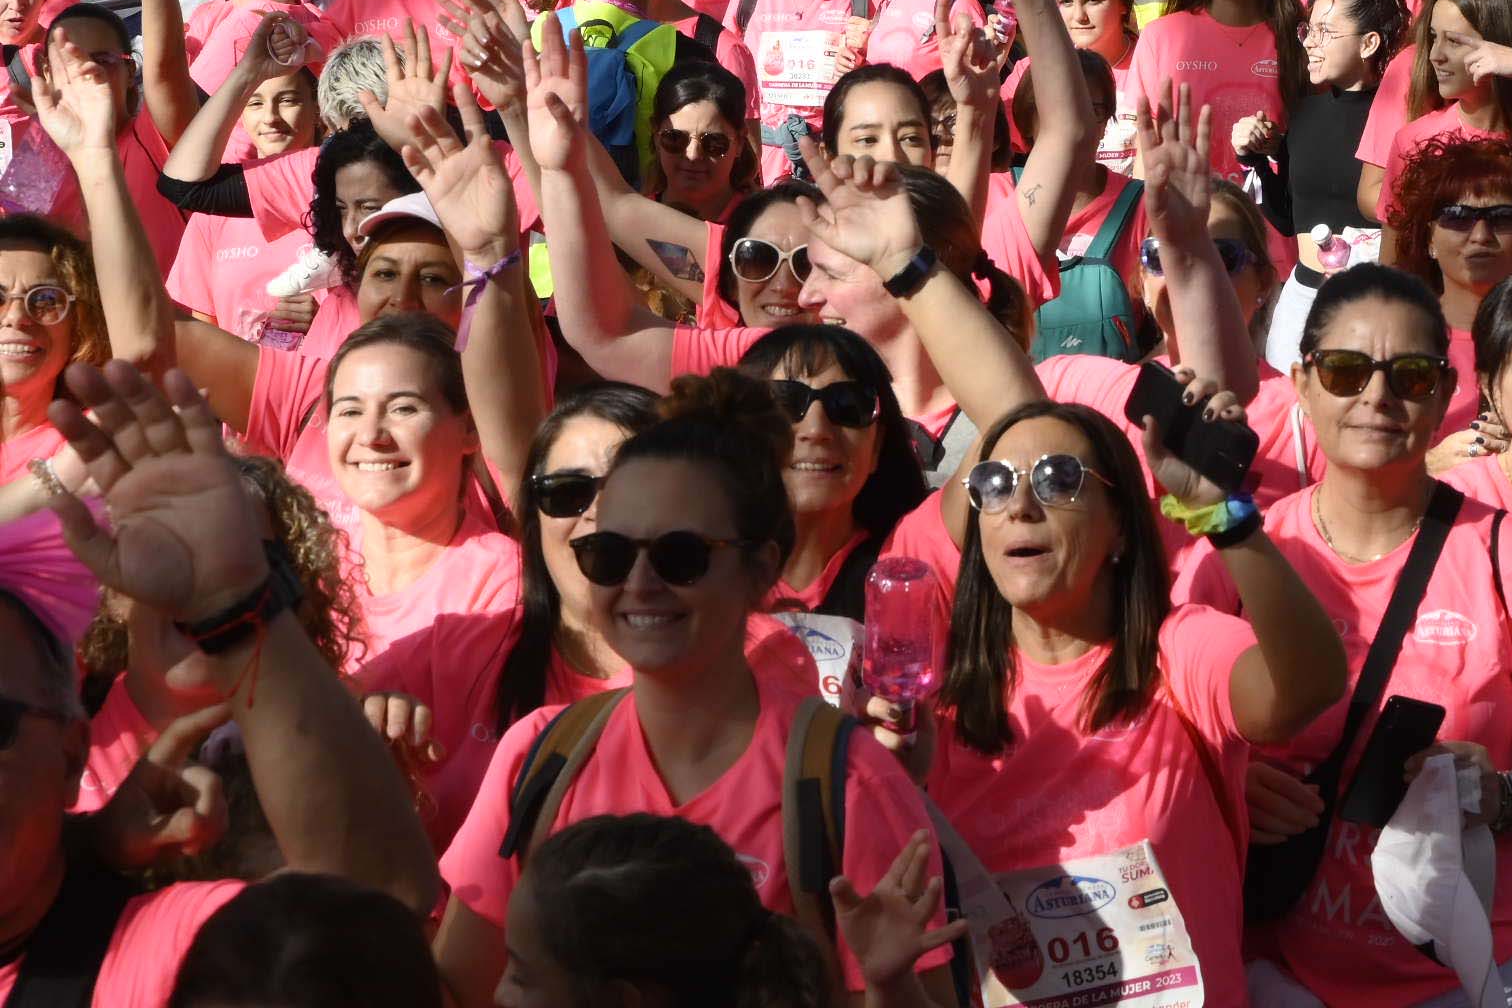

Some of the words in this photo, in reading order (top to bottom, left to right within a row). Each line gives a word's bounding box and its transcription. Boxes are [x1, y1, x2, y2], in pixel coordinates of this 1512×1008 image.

[1176, 60, 1218, 71] OYSHO
[216, 245, 259, 261] OYSHO
[1034, 888, 1111, 914] ASTURIANA
[1047, 926, 1120, 964] 016
[1061, 962, 1119, 989] 18354
[1109, 981, 1151, 1001] MUJER
[1156, 973, 1183, 988] 2023
